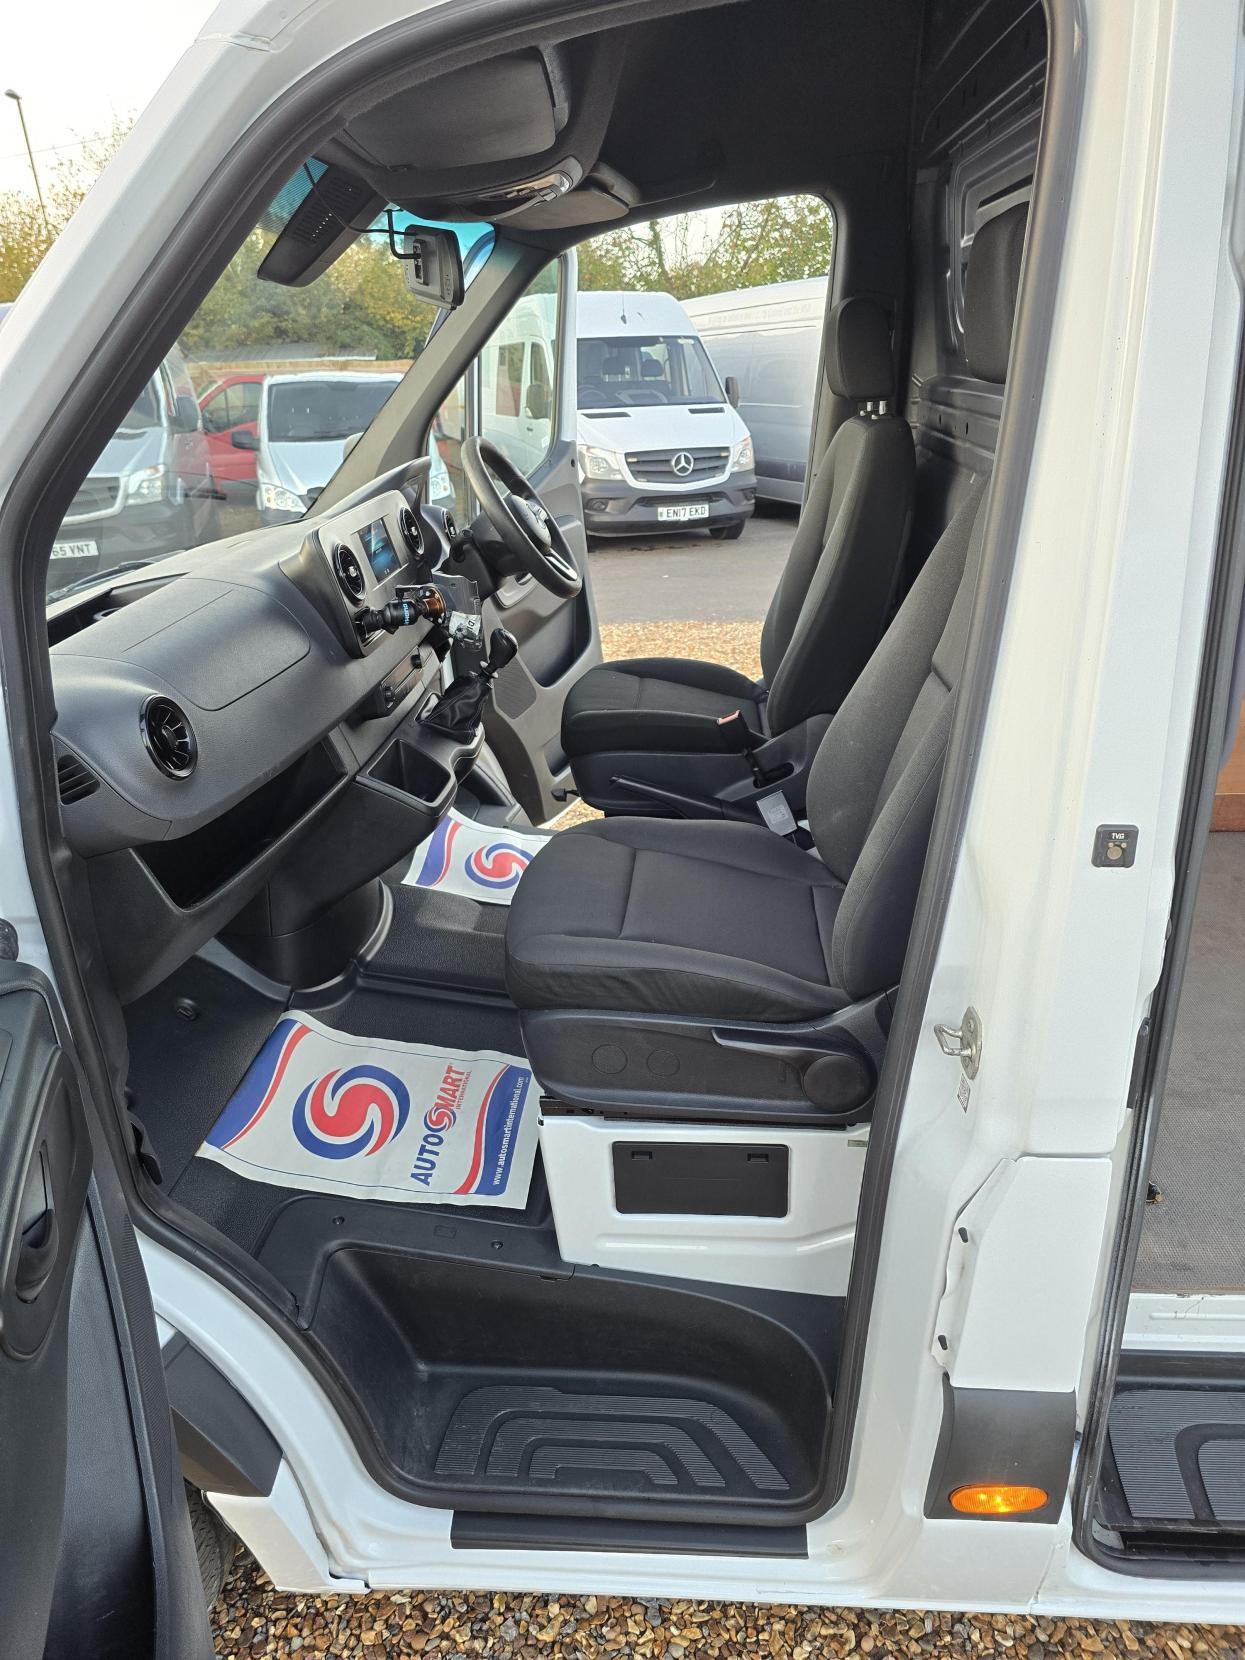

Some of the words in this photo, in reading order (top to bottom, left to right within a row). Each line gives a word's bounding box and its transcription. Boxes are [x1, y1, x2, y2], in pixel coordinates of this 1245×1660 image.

[69, 543, 91, 555] VNT
[1111, 832, 1125, 840] TVG
[455, 1070, 473, 1110] INTERNATIONAL
[493, 1077, 525, 1186] www.autosmartinternational.com
